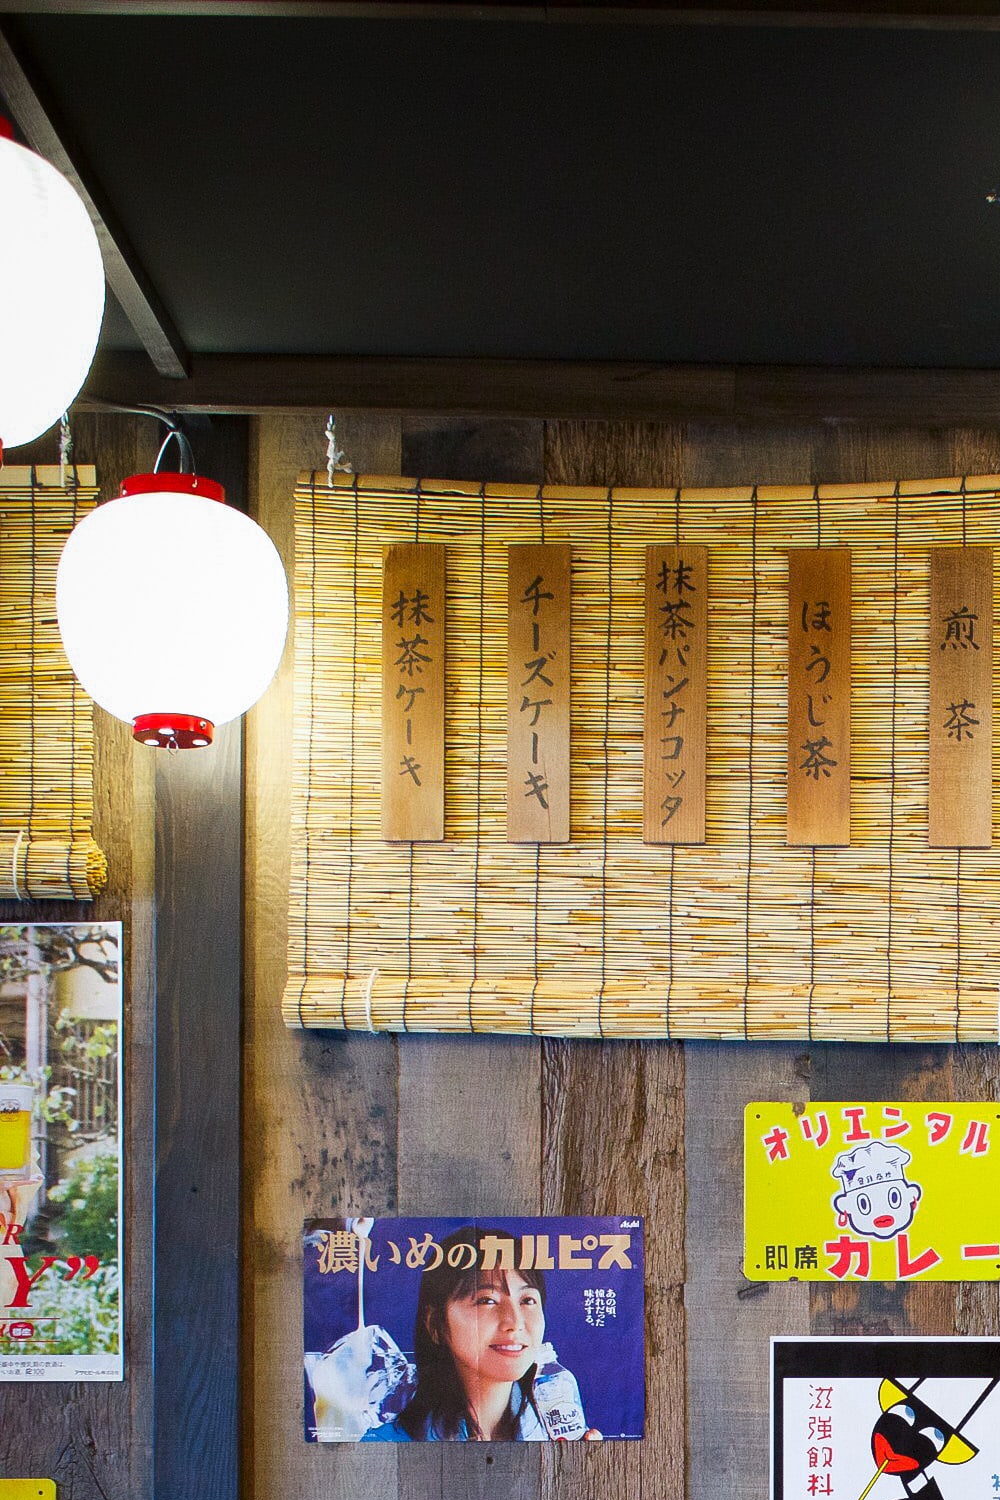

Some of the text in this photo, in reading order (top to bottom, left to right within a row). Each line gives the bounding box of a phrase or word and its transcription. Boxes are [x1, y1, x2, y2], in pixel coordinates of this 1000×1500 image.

[391, 590, 434, 788] 抹茶ケーキ
[519, 574, 556, 810] チーズケーキ
[655, 560, 697, 827] 抹茶パンナコッタ
[799, 600, 840, 781] ほうじ茶
[939, 606, 981, 742] 煎茶
[763, 1106, 990, 1163] オリエンタル
[316, 1230, 634, 1275] 濃いめのカルピス
[806, 1384, 834, 1497] 滋強飲料
